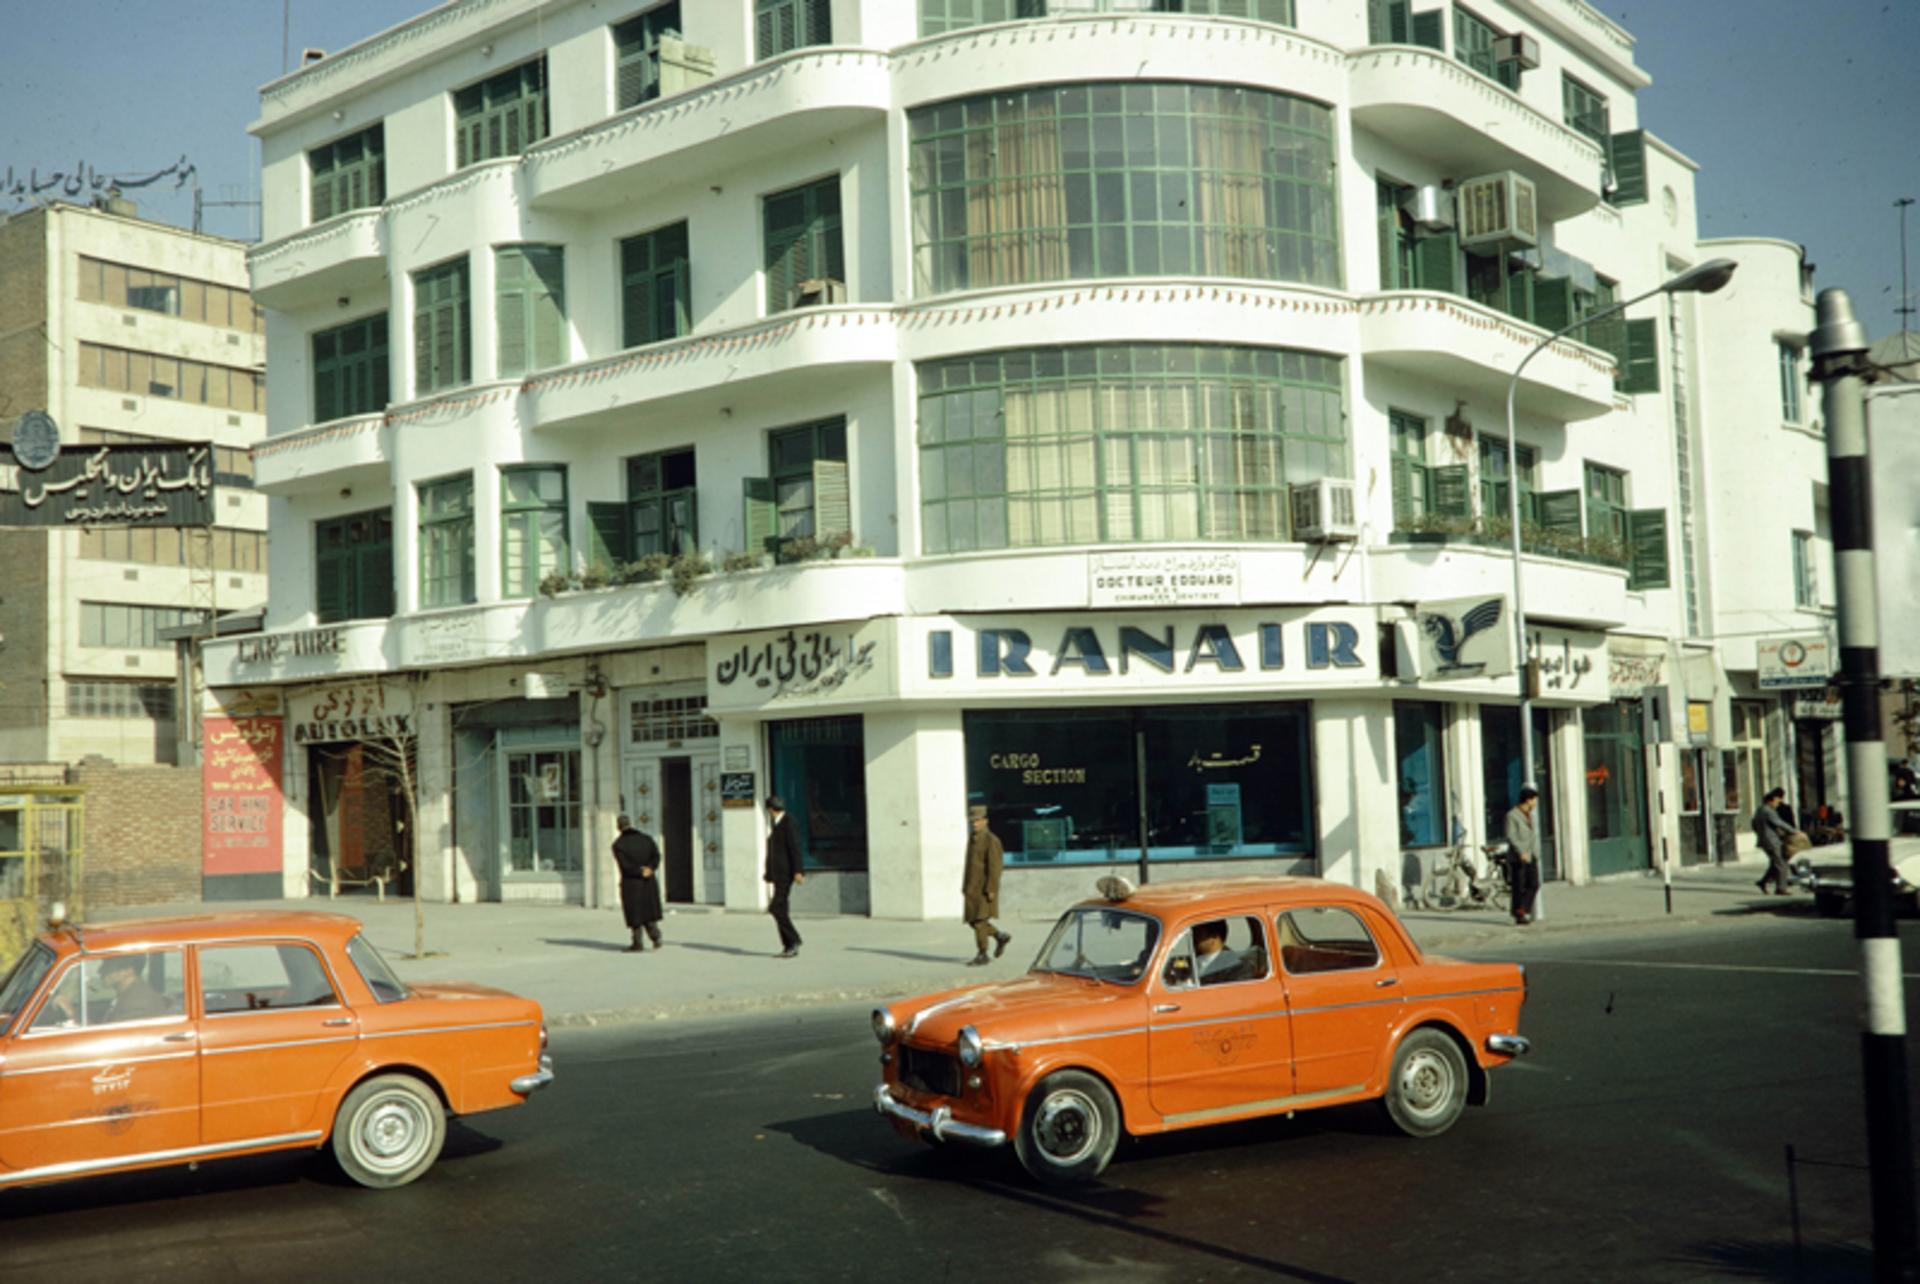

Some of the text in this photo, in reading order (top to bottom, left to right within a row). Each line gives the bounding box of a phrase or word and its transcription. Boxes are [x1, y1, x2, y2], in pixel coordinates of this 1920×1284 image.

[0, 164, 64, 203] حسابدا
[118, 455, 168, 499] ایران
[157, 447, 212, 497] بانک
[1096, 574, 1234, 589] DOCTEUR EDOUARD
[238, 630, 347, 663] CAR HIRE
[716, 643, 773, 689] ایران
[989, 752, 1040, 770] CARGO
[1022, 768, 1087, 785] SECTION
[208, 815, 267, 833] SERVICE
